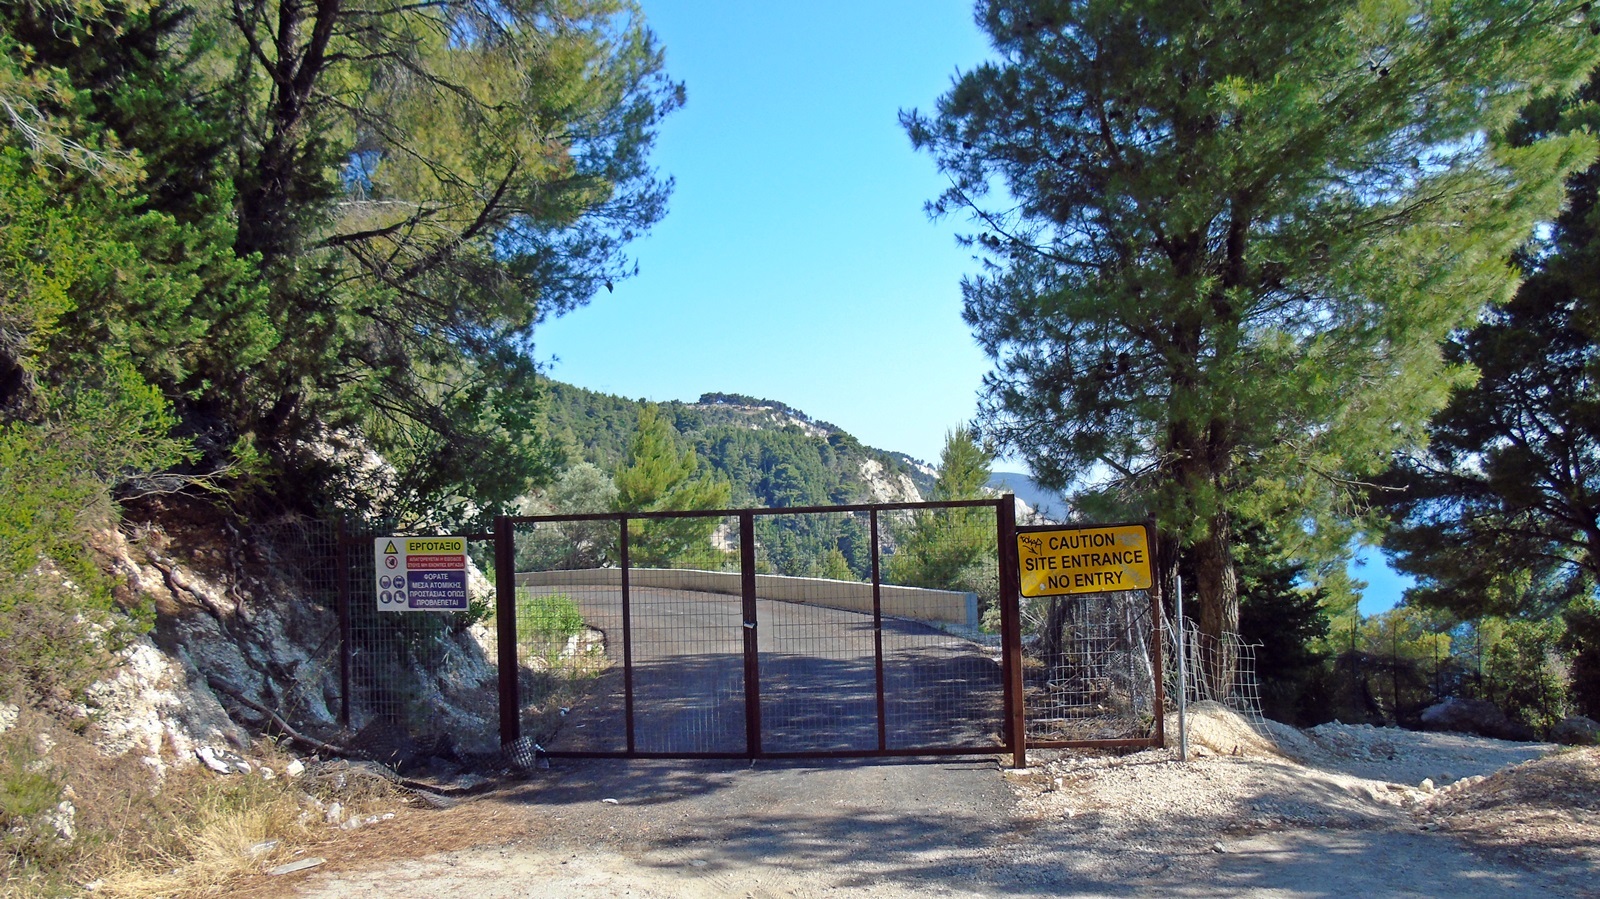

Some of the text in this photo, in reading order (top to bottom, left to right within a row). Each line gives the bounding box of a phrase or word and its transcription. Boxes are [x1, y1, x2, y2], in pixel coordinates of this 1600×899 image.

[409, 541, 462, 551] ΕΡΓΟΤΑΞΙΟ
[1049, 533, 1115, 550] CAUTION
[1025, 550, 1144, 571] SITE ENTRANCE
[1048, 571, 1123, 589] NO ENTRY
[447, 590, 465, 598] ΟΠΩΣ
